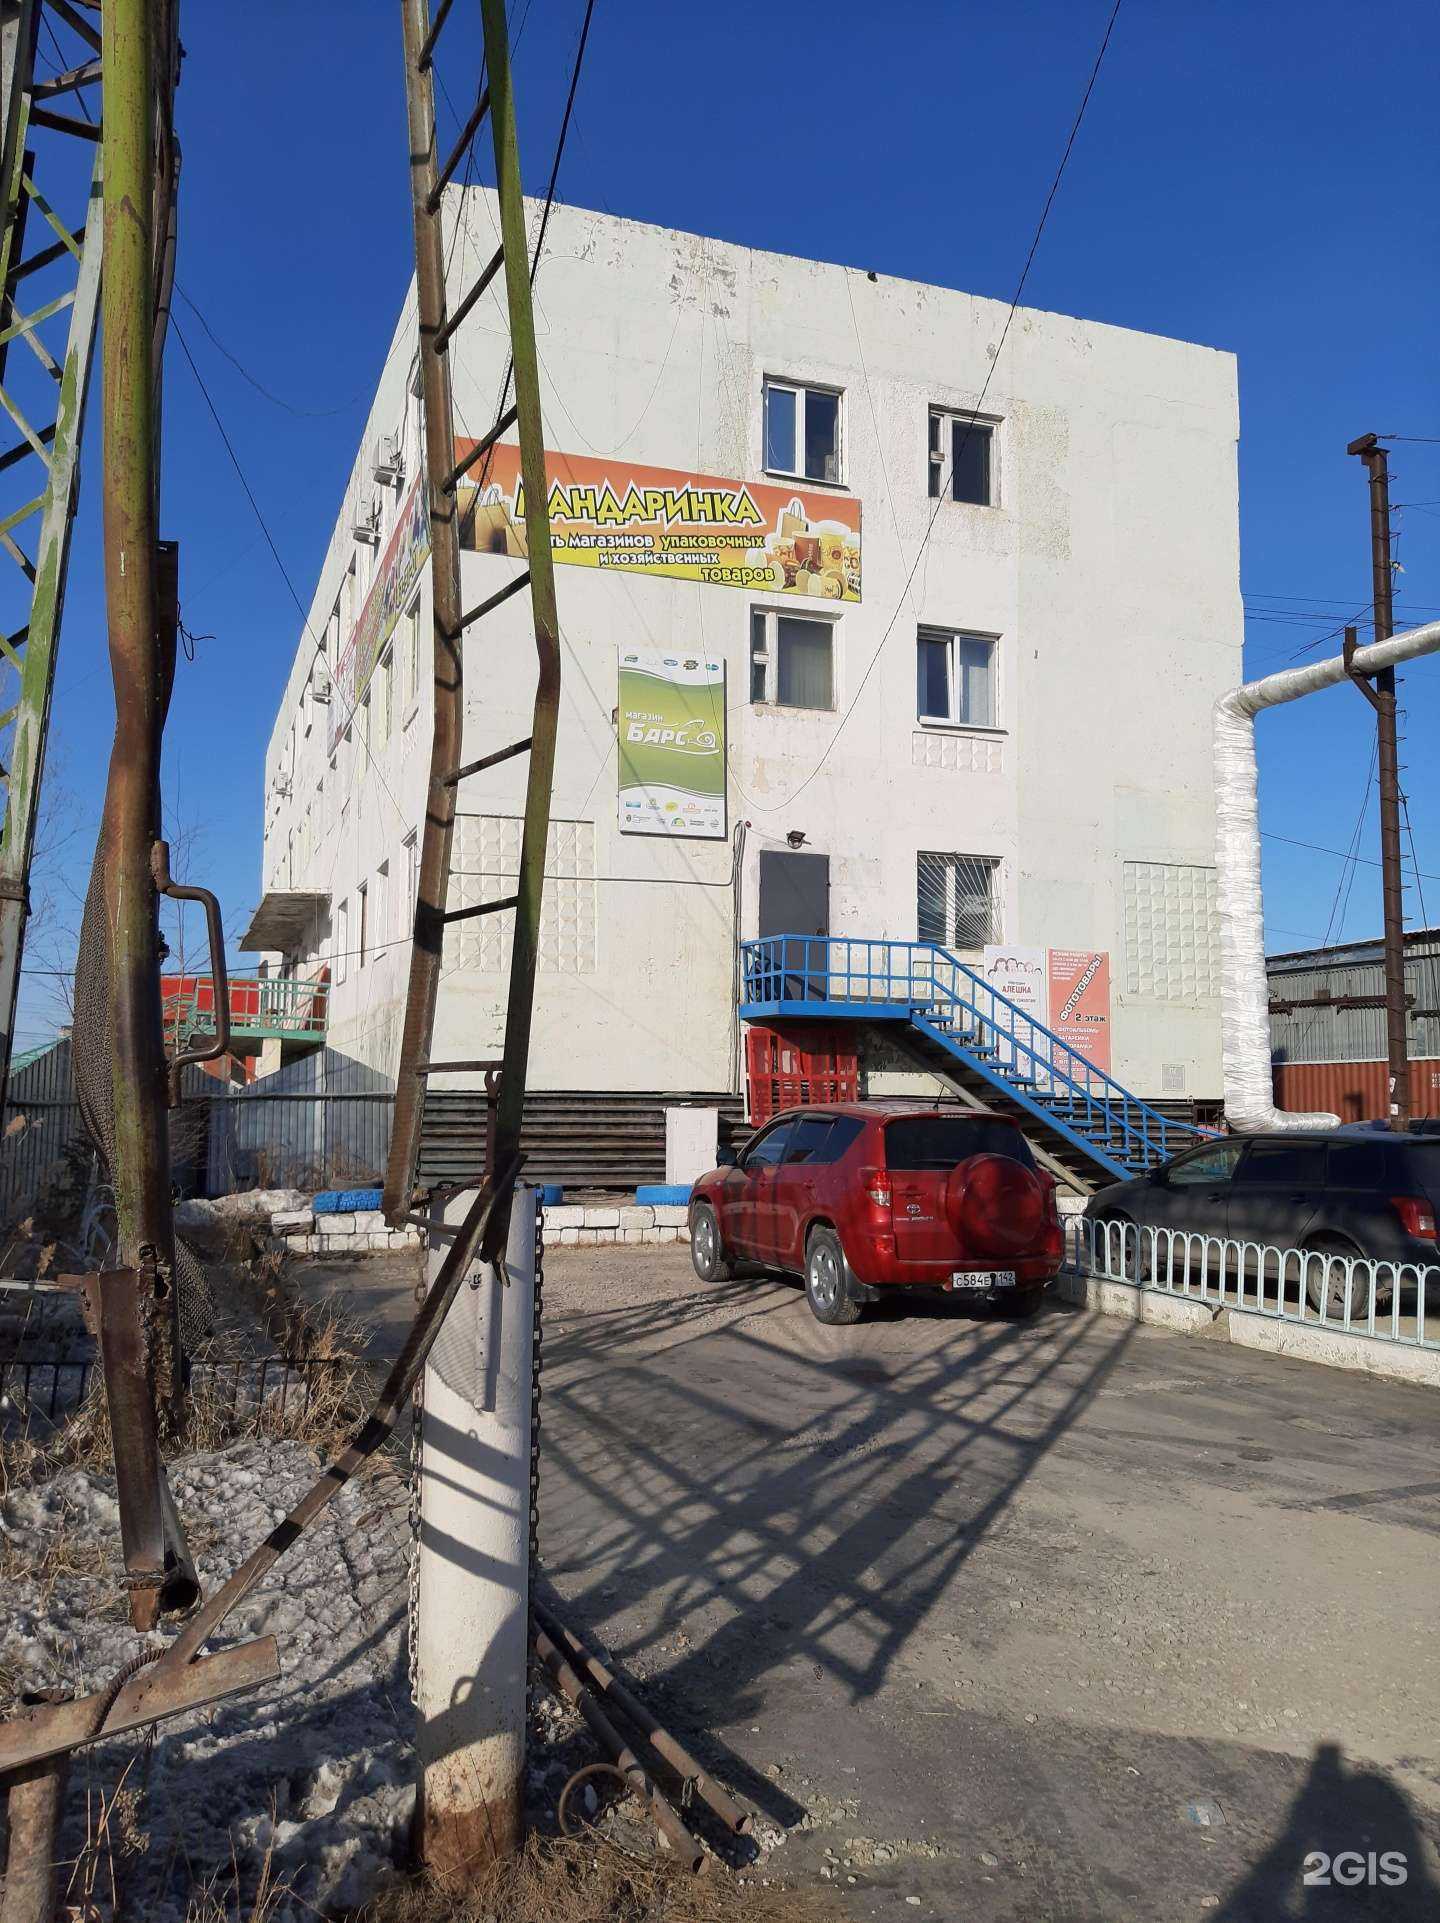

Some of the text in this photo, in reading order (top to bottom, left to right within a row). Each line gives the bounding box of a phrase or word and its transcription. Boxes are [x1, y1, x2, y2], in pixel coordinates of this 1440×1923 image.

[661, 535, 766, 551] упаковочных
[599, 550, 719, 567] и хозяйственных
[701, 567, 775, 584] товаров
[1002, 985, 1032, 994] АЛЕШКА
[1060, 954, 1103, 1021] ФОТОТОВАРЫ
[1075, 1013, 1082, 1022] 2
